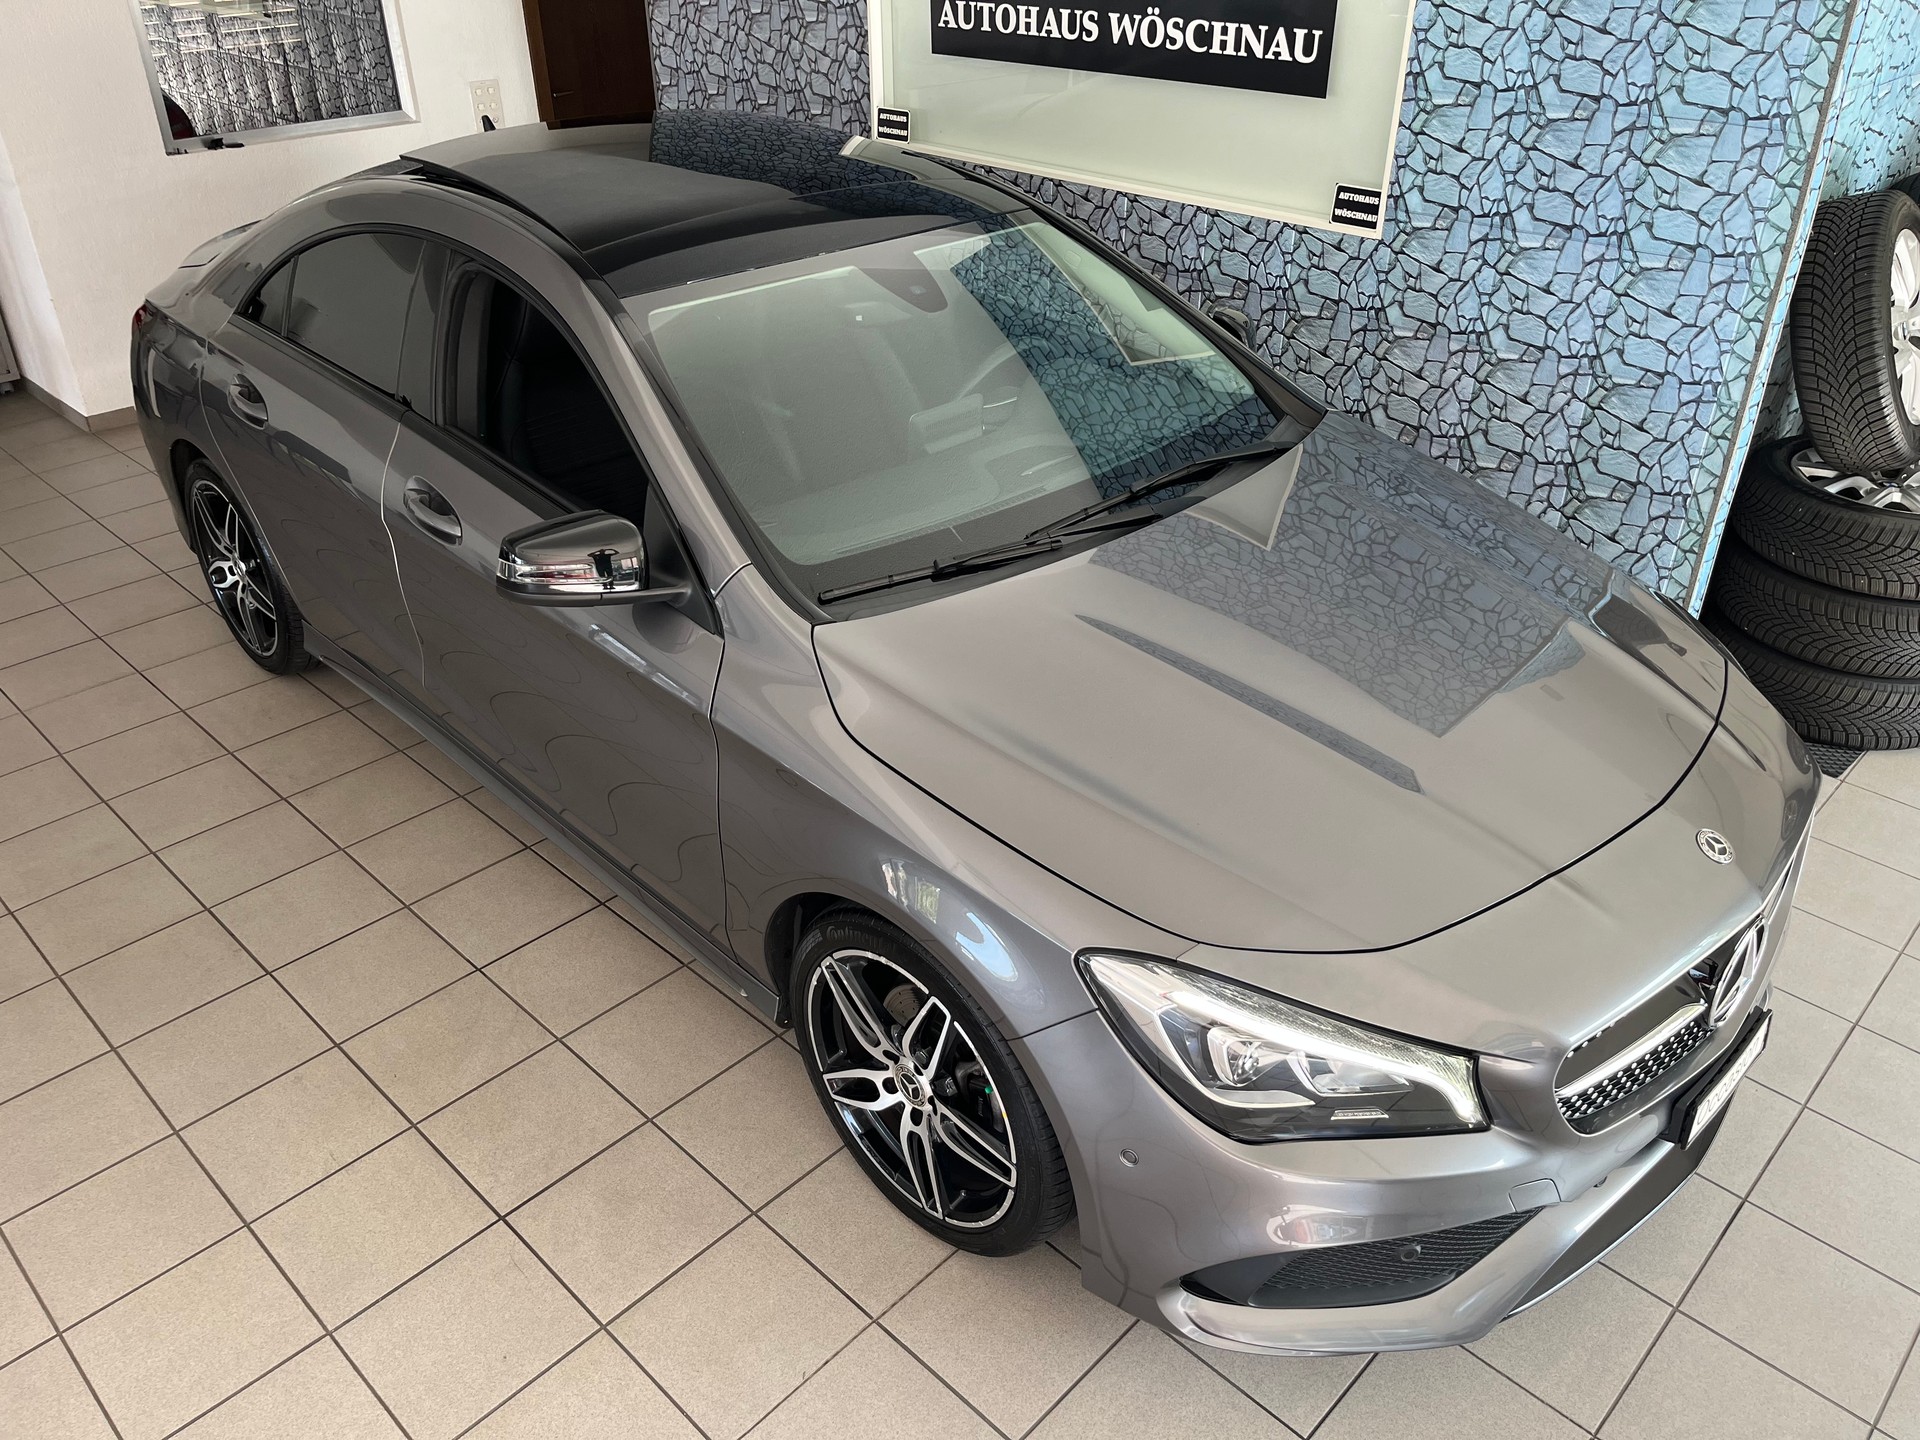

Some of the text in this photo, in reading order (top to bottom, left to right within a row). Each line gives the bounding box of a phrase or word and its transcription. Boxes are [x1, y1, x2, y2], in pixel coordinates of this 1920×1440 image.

[938, 0, 1323, 64] AUTOHAUS WÖSCHNAU
[879, 113, 907, 123] AUTOHAUS
[878, 126, 908, 136] WÖSCHNAU
[1338, 191, 1380, 205] AUTOHAUS
[1334, 207, 1378, 222] WÖSCHNAU
